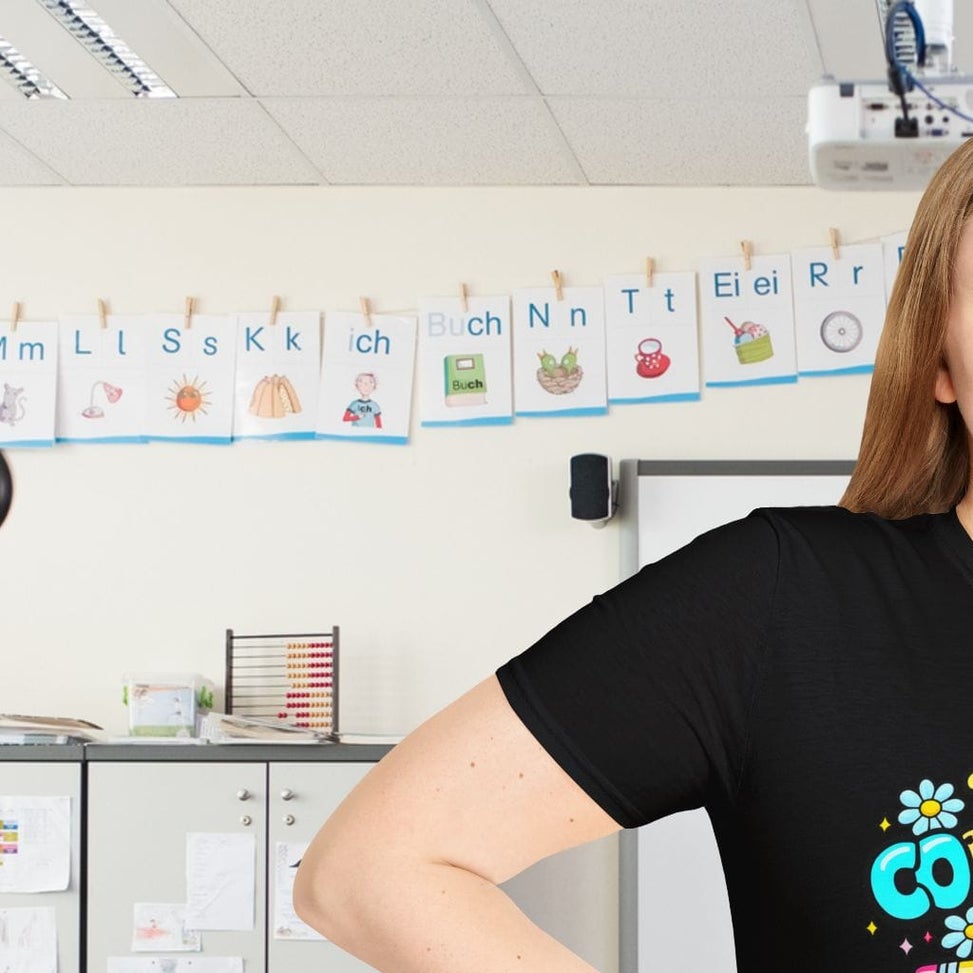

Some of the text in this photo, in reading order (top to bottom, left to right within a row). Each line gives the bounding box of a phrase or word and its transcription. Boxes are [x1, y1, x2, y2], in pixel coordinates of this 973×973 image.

[713, 269, 778, 298] Ei ei
[809, 262, 864, 288] R r
[620, 288, 675, 314] T t
[427, 309, 503, 338] Buch
[528, 302, 587, 328] N n
[19, 342, 45, 361] m
[75, 329, 92, 355] L
[161, 327, 218, 356] S s
[245, 326, 302, 352] K k
[347, 327, 393, 356] ich
[451, 378, 484, 392] Buch
